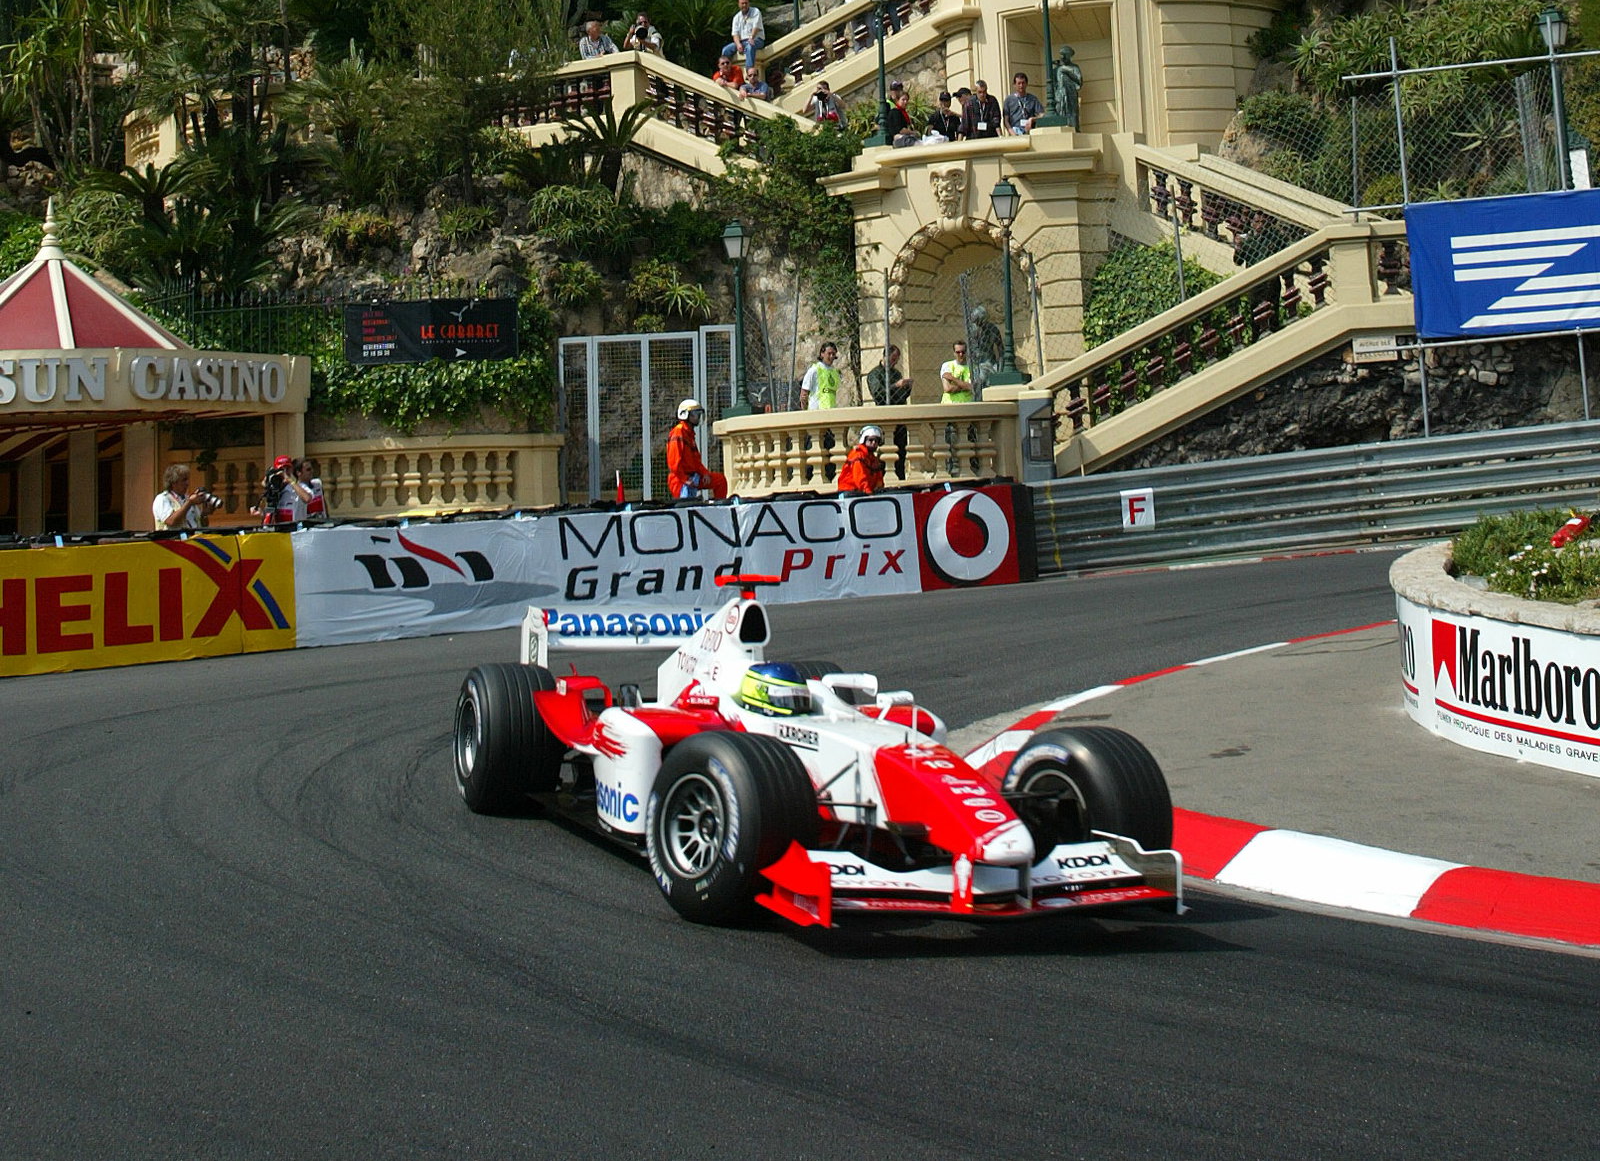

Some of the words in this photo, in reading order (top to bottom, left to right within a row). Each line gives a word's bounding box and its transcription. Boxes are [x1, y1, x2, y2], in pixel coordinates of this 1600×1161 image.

[130, 356, 287, 404] CASINO
[558, 496, 903, 561] MONACO
[1128, 497, 1146, 525] F
[564, 556, 743, 600] Grand
[780, 544, 906, 583] Prix
[544, 607, 716, 637] Panasoni
[1458, 625, 1600, 731] Marlboro
[1453, 717, 1490, 739] PROVOQUE
[1494, 731, 1513, 743] DES
[1516, 735, 1562, 755] MALADIES
[1056, 854, 1111, 870] KDDI
